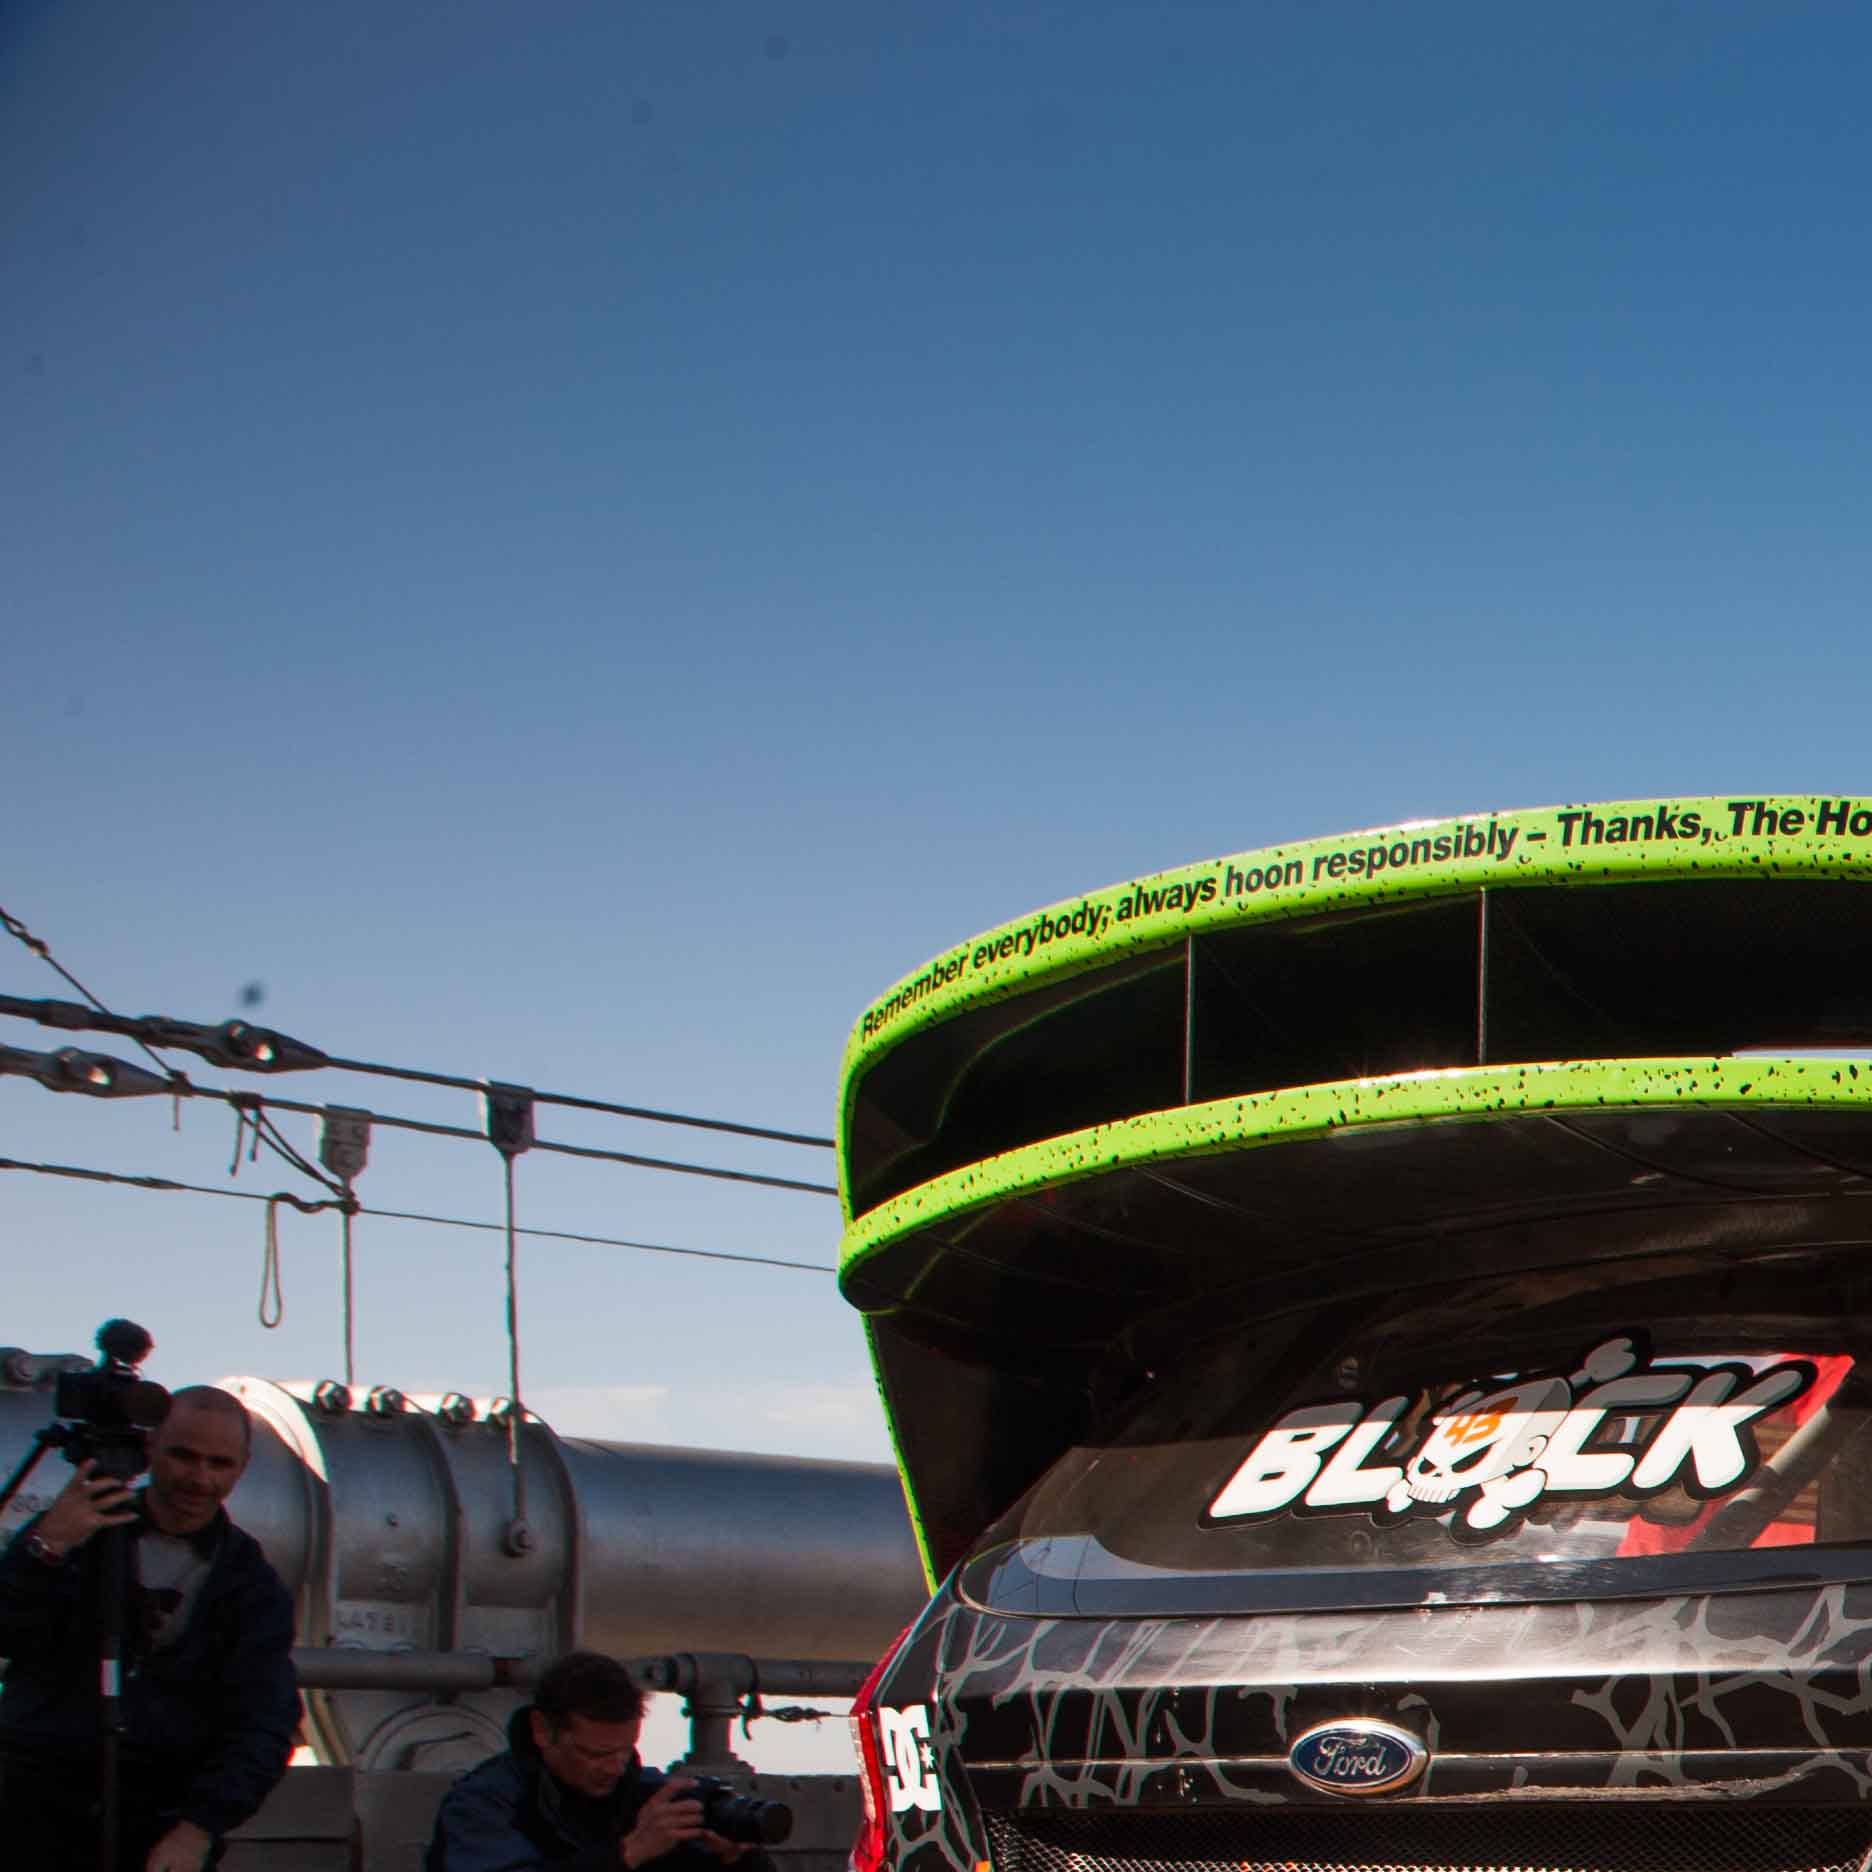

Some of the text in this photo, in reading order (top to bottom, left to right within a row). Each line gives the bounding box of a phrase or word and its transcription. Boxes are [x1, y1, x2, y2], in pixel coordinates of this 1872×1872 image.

[862, 952, 968, 1042] Remember
[973, 904, 1111, 971] everybody;
[1117, 877, 1217, 923] always
[1225, 858, 1303, 898] hoon
[1312, 820, 1519, 881] responsibly
[1557, 805, 1712, 848] Thanks,
[1726, 801, 1805, 837] The
[1312, 1736, 1389, 1777] Ford
